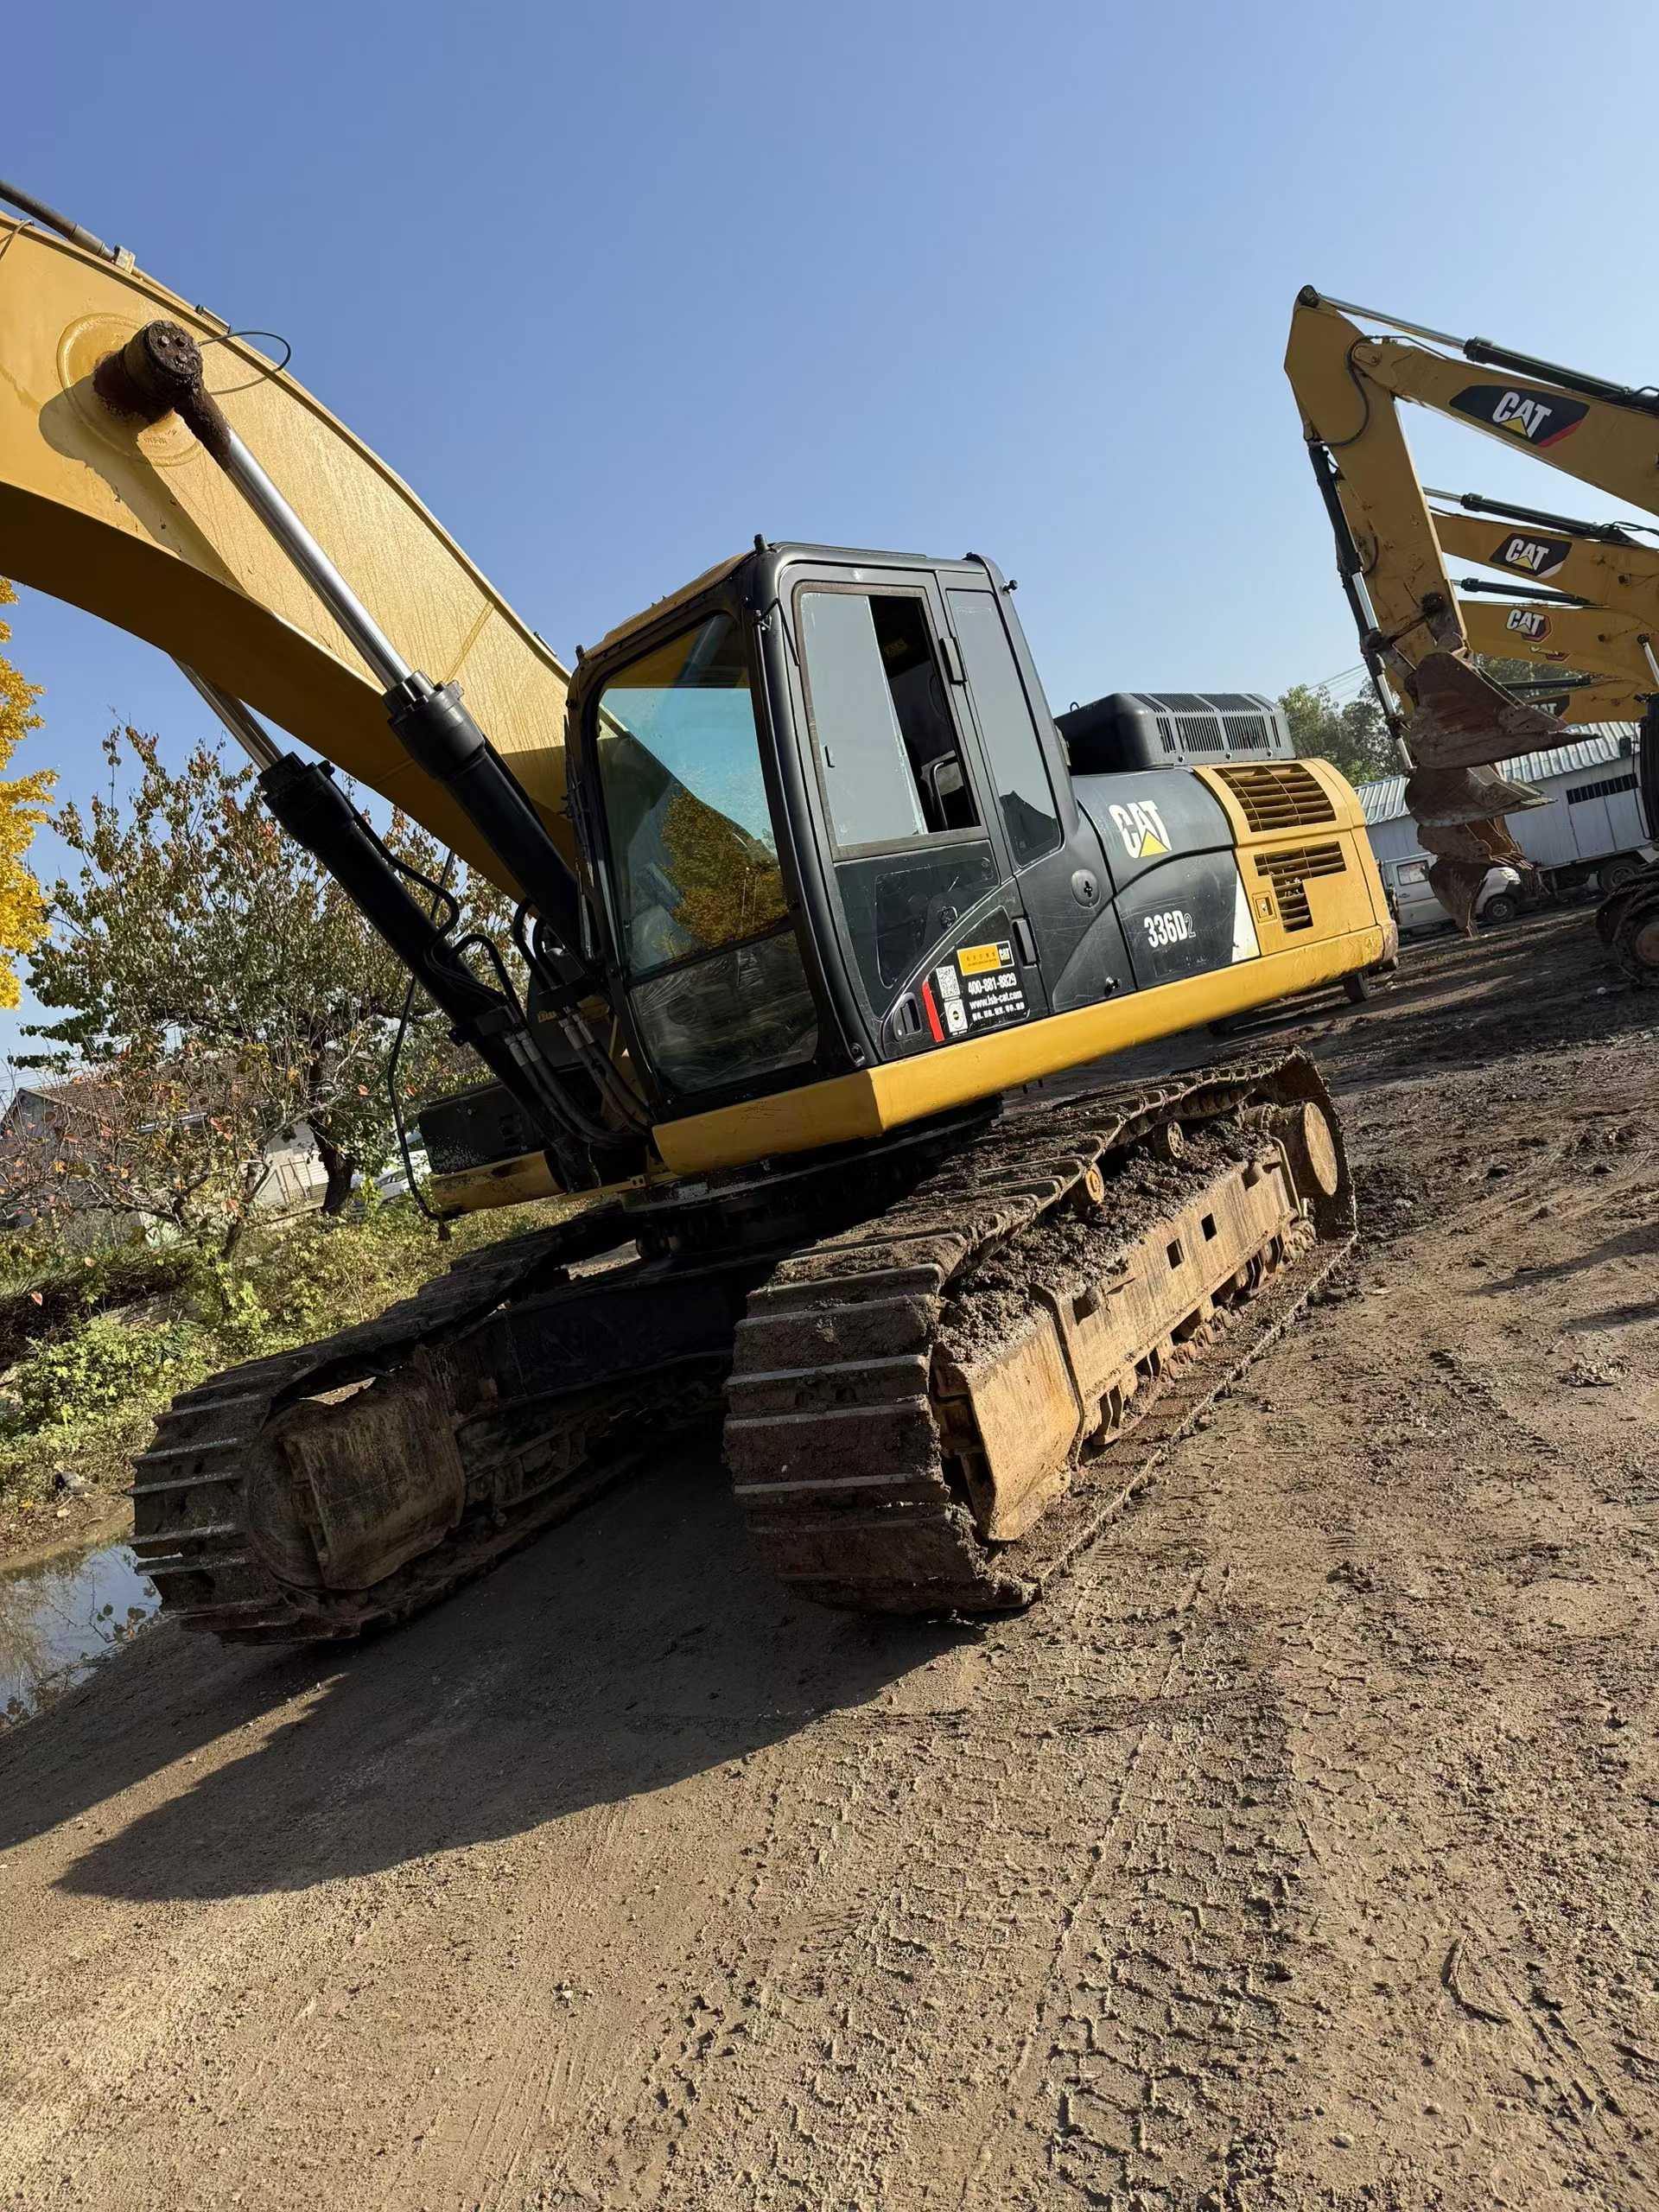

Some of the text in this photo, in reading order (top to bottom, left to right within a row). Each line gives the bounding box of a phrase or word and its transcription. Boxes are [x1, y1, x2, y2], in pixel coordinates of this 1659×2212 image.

[1492, 391, 1552, 438] CAT
[1505, 538, 1550, 570] CAT
[1507, 609, 1545, 634] CAT
[1109, 800, 1173, 859] CAT
[1143, 910, 1197, 949] 336D2
[968, 972, 1017, 995] 400-881-8829
